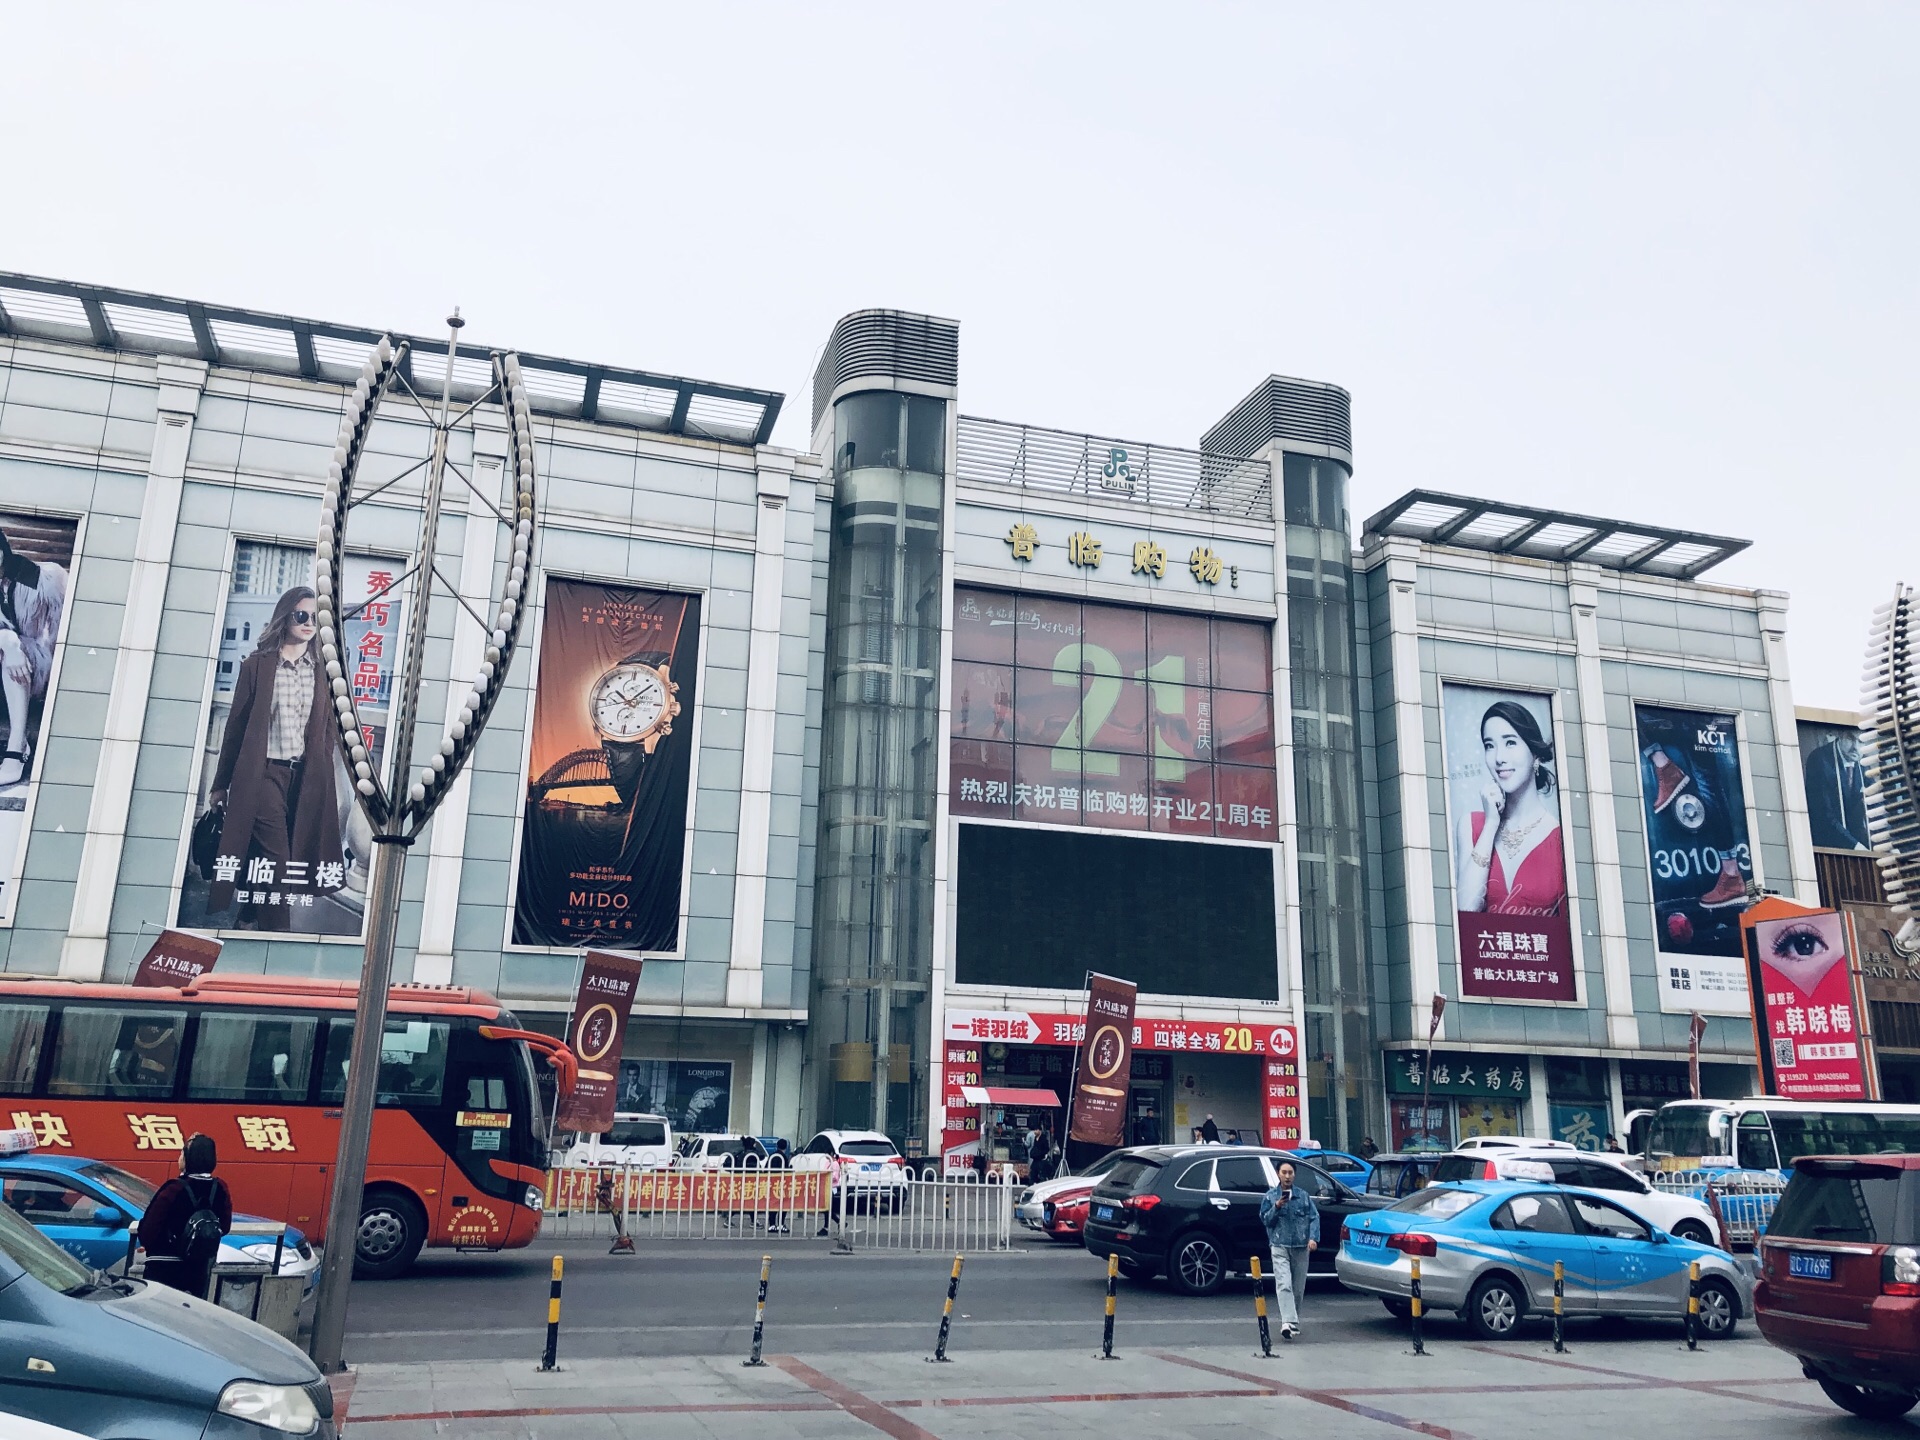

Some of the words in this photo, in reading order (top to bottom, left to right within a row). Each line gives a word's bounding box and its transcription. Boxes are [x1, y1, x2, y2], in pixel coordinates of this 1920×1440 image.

[1105, 479, 1135, 491] PULIN
[1004, 524, 1223, 584] 普临购物
[1051, 642, 1186, 784] 21
[1196, 702, 1212, 751] 周年庆
[1696, 729, 1727, 746] KCT
[212, 854, 344, 888] 普临三楼
[236, 890, 314, 907] 巴丽景专柜
[569, 890, 629, 909] MIDO
[1488, 883, 1566, 917] eloved
[1477, 930, 1549, 953] 六福珠寶
[1479, 950, 1510, 960] LUKFOOK
[1511, 952, 1550, 962] JEWELLERY
[1472, 967, 1559, 984] 普临大凡珠宝广场
[1767, 991, 1795, 1006] 眼整形
[951, 1018, 1029, 1040] 一诺羽绒
[1785, 1004, 1852, 1035] 韩晓梅
[687, 1069, 725, 1077] LONGINES
[1405, 1061, 1525, 1092] 普临大药房
[965, 1117, 976, 1130] 20
